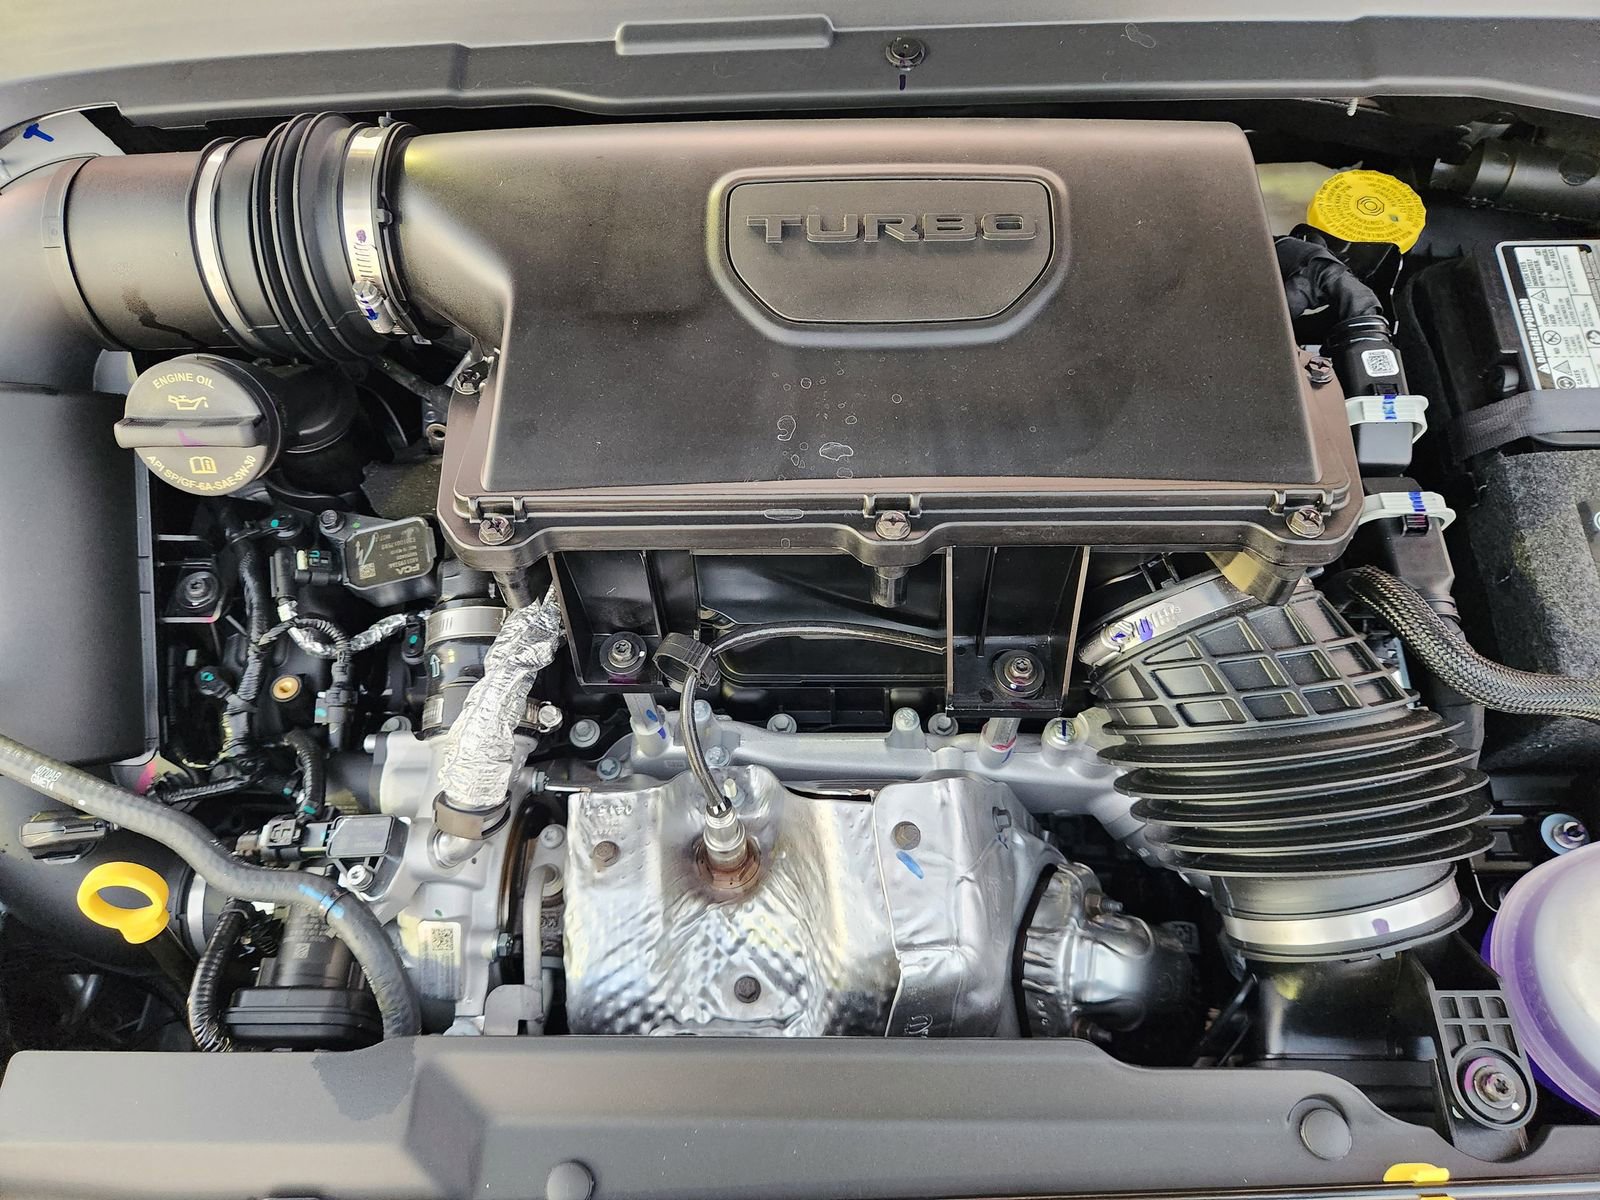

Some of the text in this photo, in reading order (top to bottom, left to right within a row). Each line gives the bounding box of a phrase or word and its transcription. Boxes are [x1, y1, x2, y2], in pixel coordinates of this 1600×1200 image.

[746, 213, 1037, 243] TURBO
[1519, 298, 1547, 363] DANGER/POISON
[152, 373, 216, 390] ENGINE OIL
[146, 455, 164, 472] API
[395, 563, 420, 575] FCA
